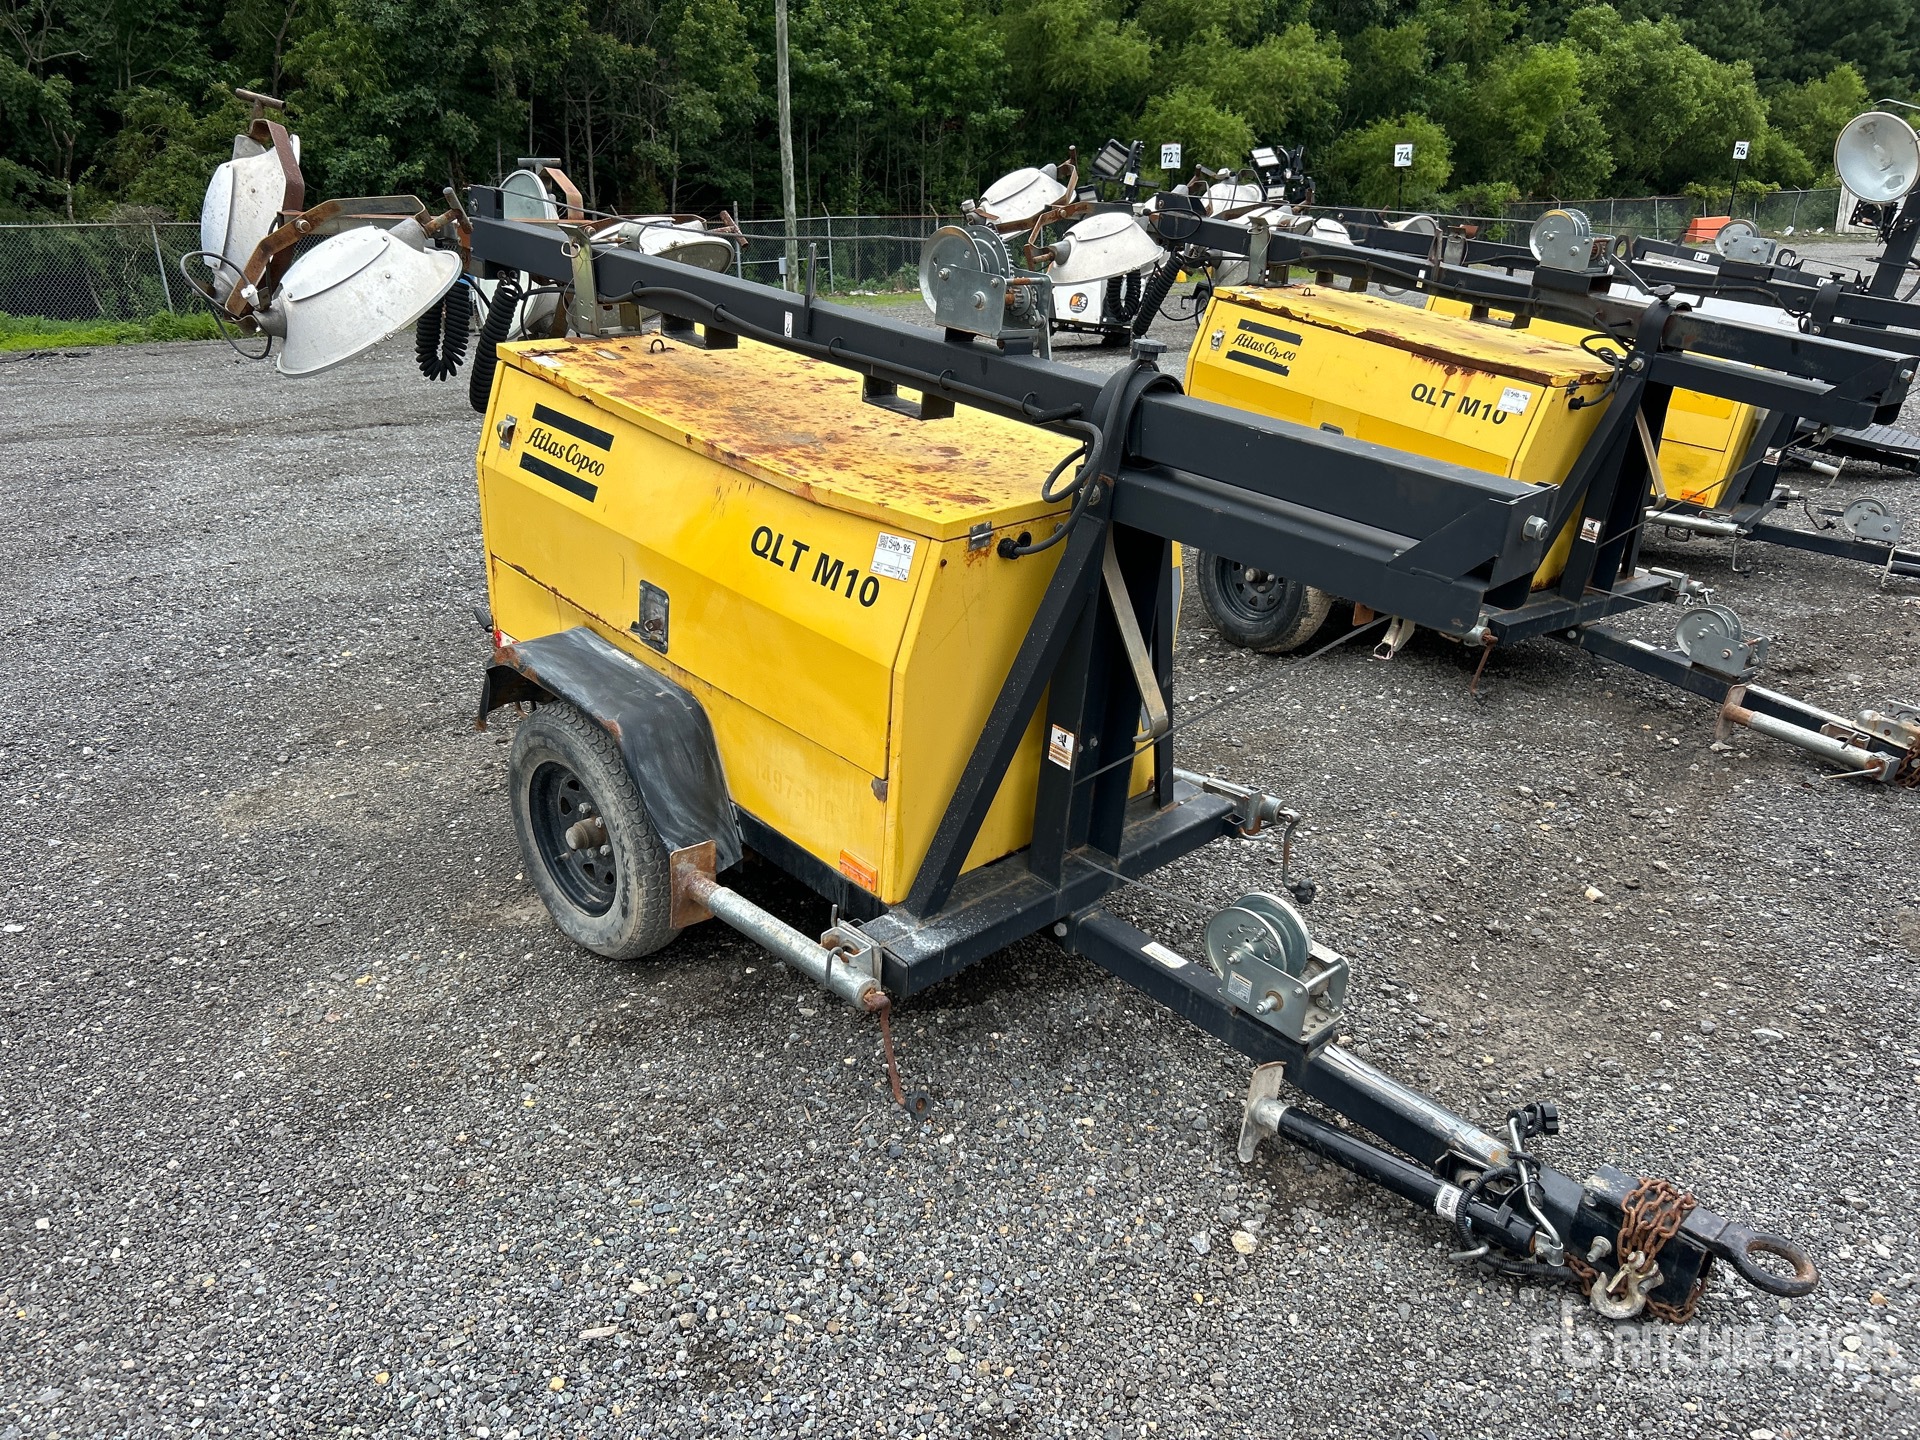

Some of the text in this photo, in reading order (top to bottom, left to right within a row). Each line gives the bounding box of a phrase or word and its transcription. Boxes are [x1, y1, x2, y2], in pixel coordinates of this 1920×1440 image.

[1163, 152, 1173, 163] 72
[1397, 152, 1410, 161] 74
[1736, 147, 1745, 155] 76
[1231, 333, 1265, 352] Atlas
[1410, 383, 1456, 408] QLT
[1456, 396, 1508, 425] M10
[525, 427, 605, 477] Atlas Copco
[750, 526, 880, 607] QLT M10
